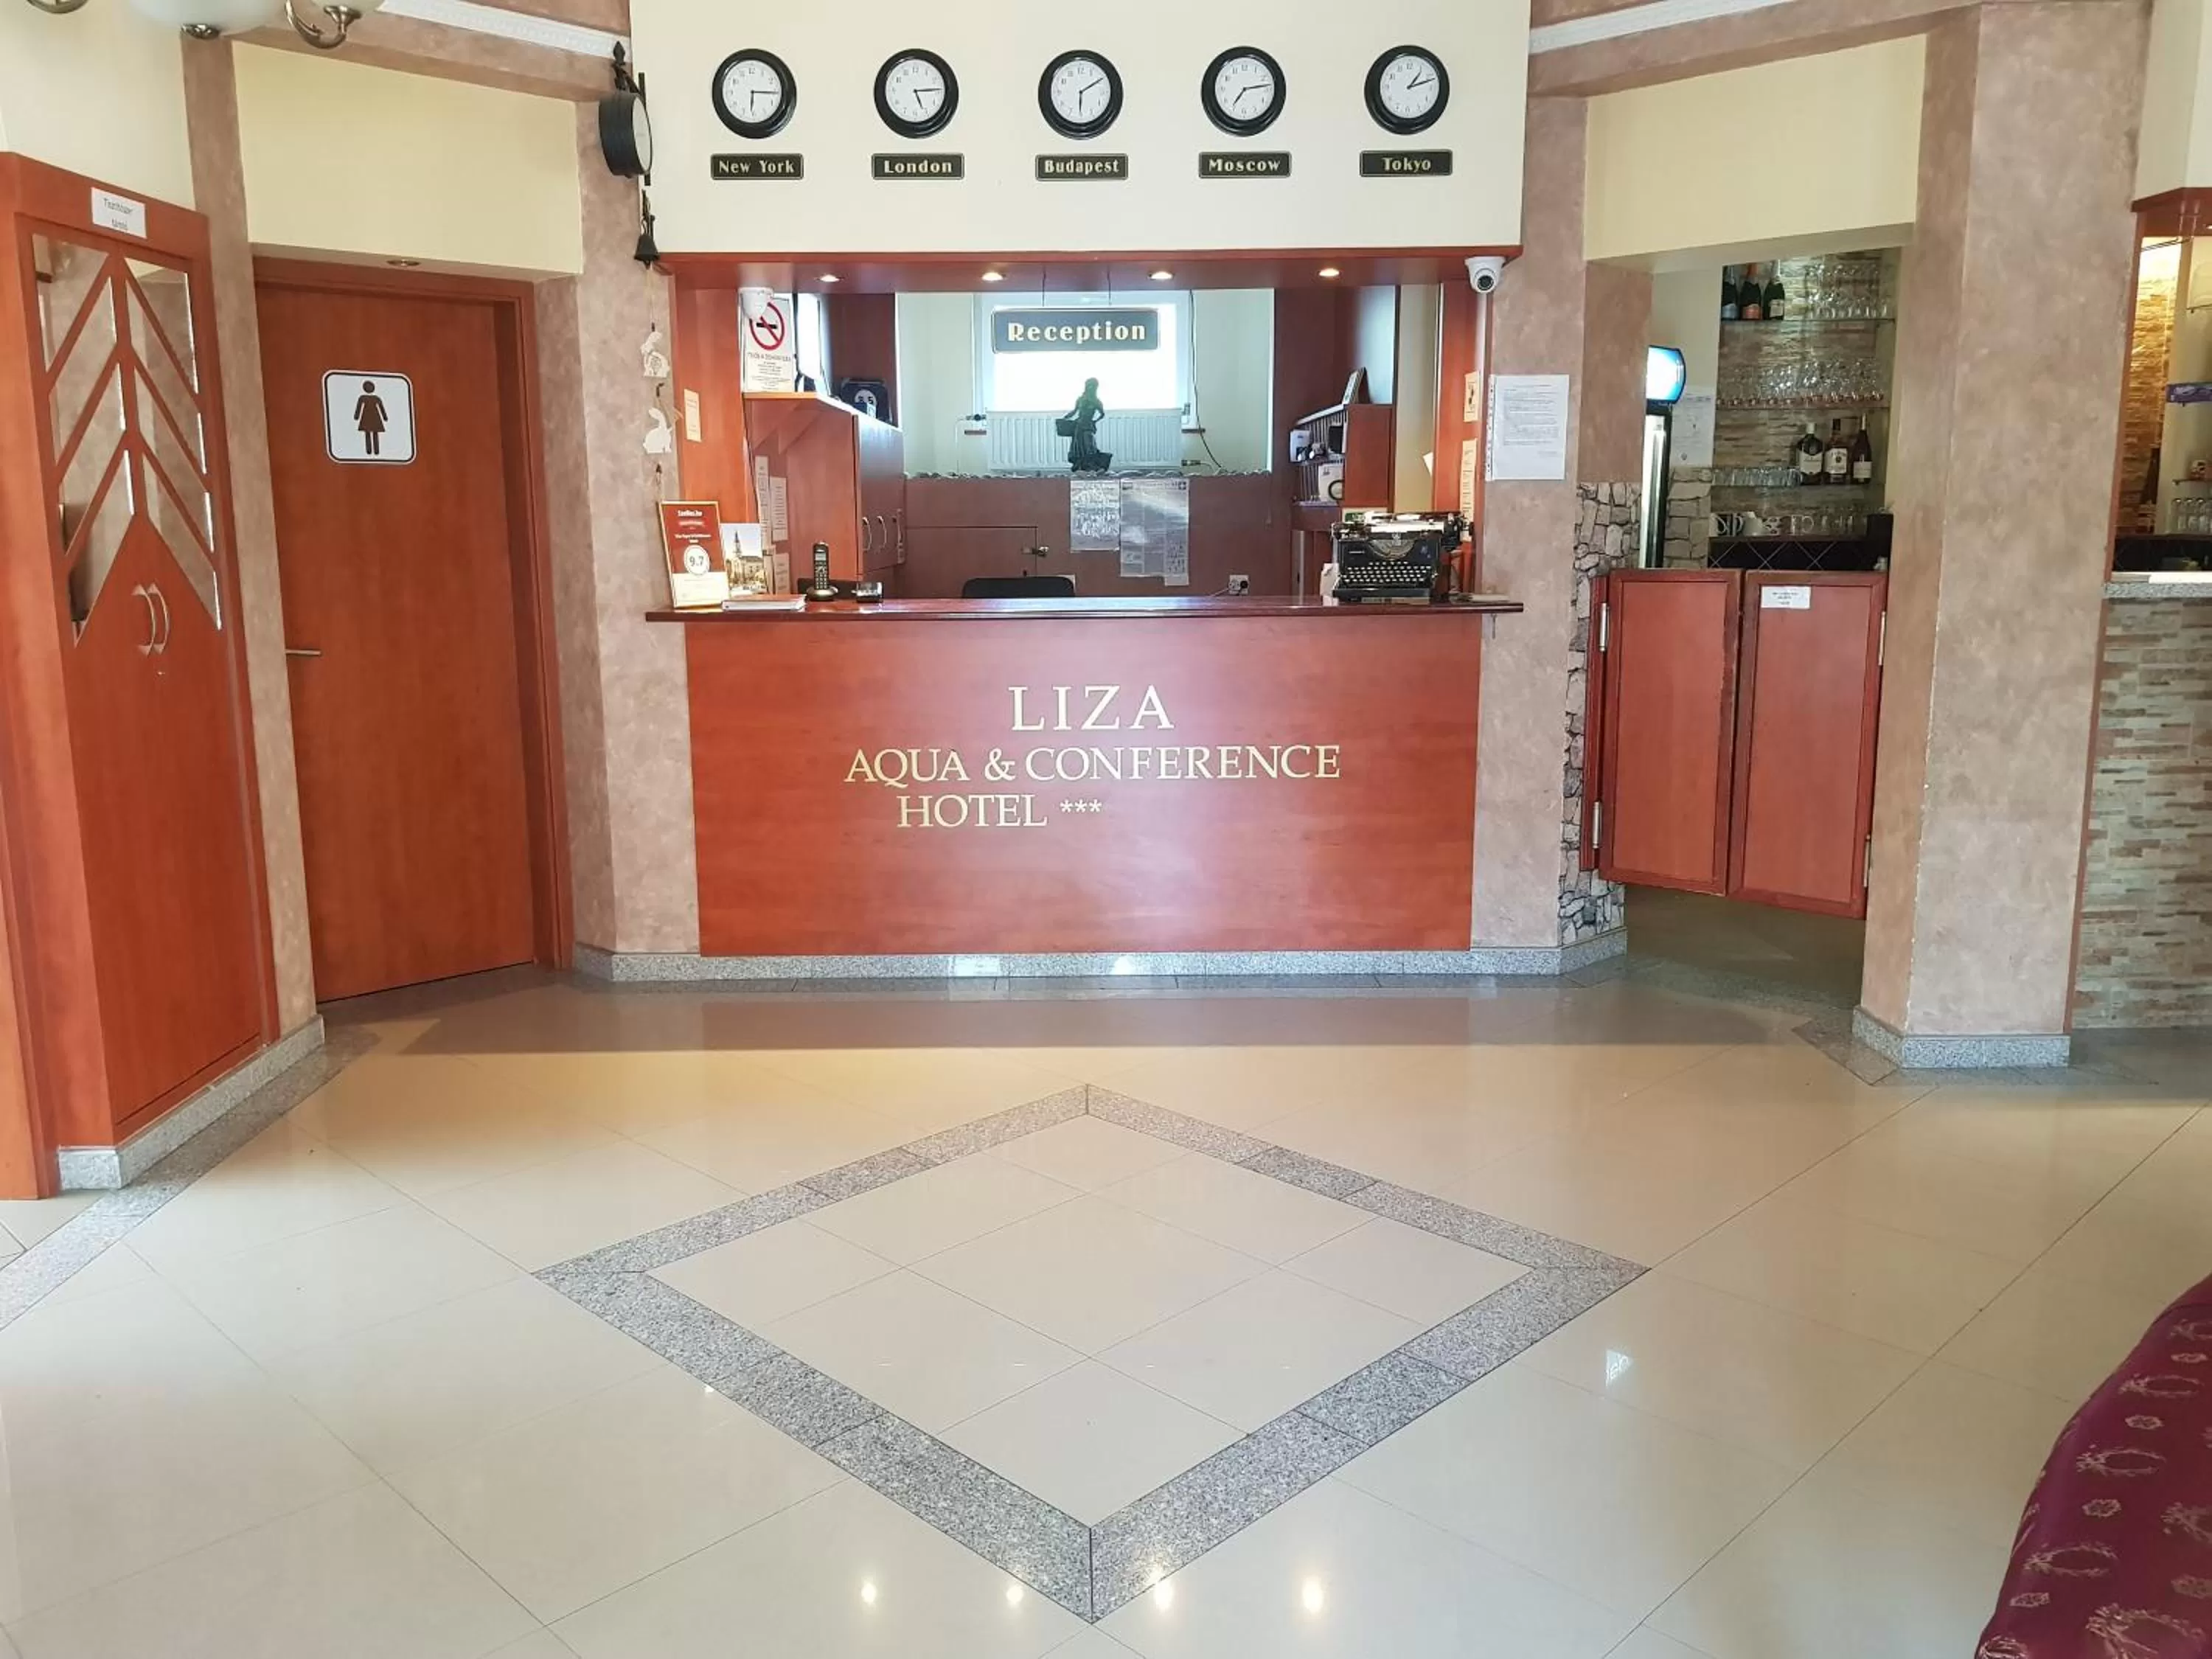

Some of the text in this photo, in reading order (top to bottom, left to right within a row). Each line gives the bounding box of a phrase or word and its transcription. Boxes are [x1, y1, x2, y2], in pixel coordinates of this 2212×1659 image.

[719, 160, 794, 173] New York
[883, 160, 952, 173] London
[1045, 159, 1119, 175] Budapest
[1208, 159, 1280, 172] Moscow
[1382, 157, 1431, 172] Tokyo
[1008, 321, 1146, 344] Reception
[1008, 685, 1175, 731] LIZA
[844, 745, 1340, 788] AQUA & CONFERENCE
[897, 794, 1048, 828] HOTEL
